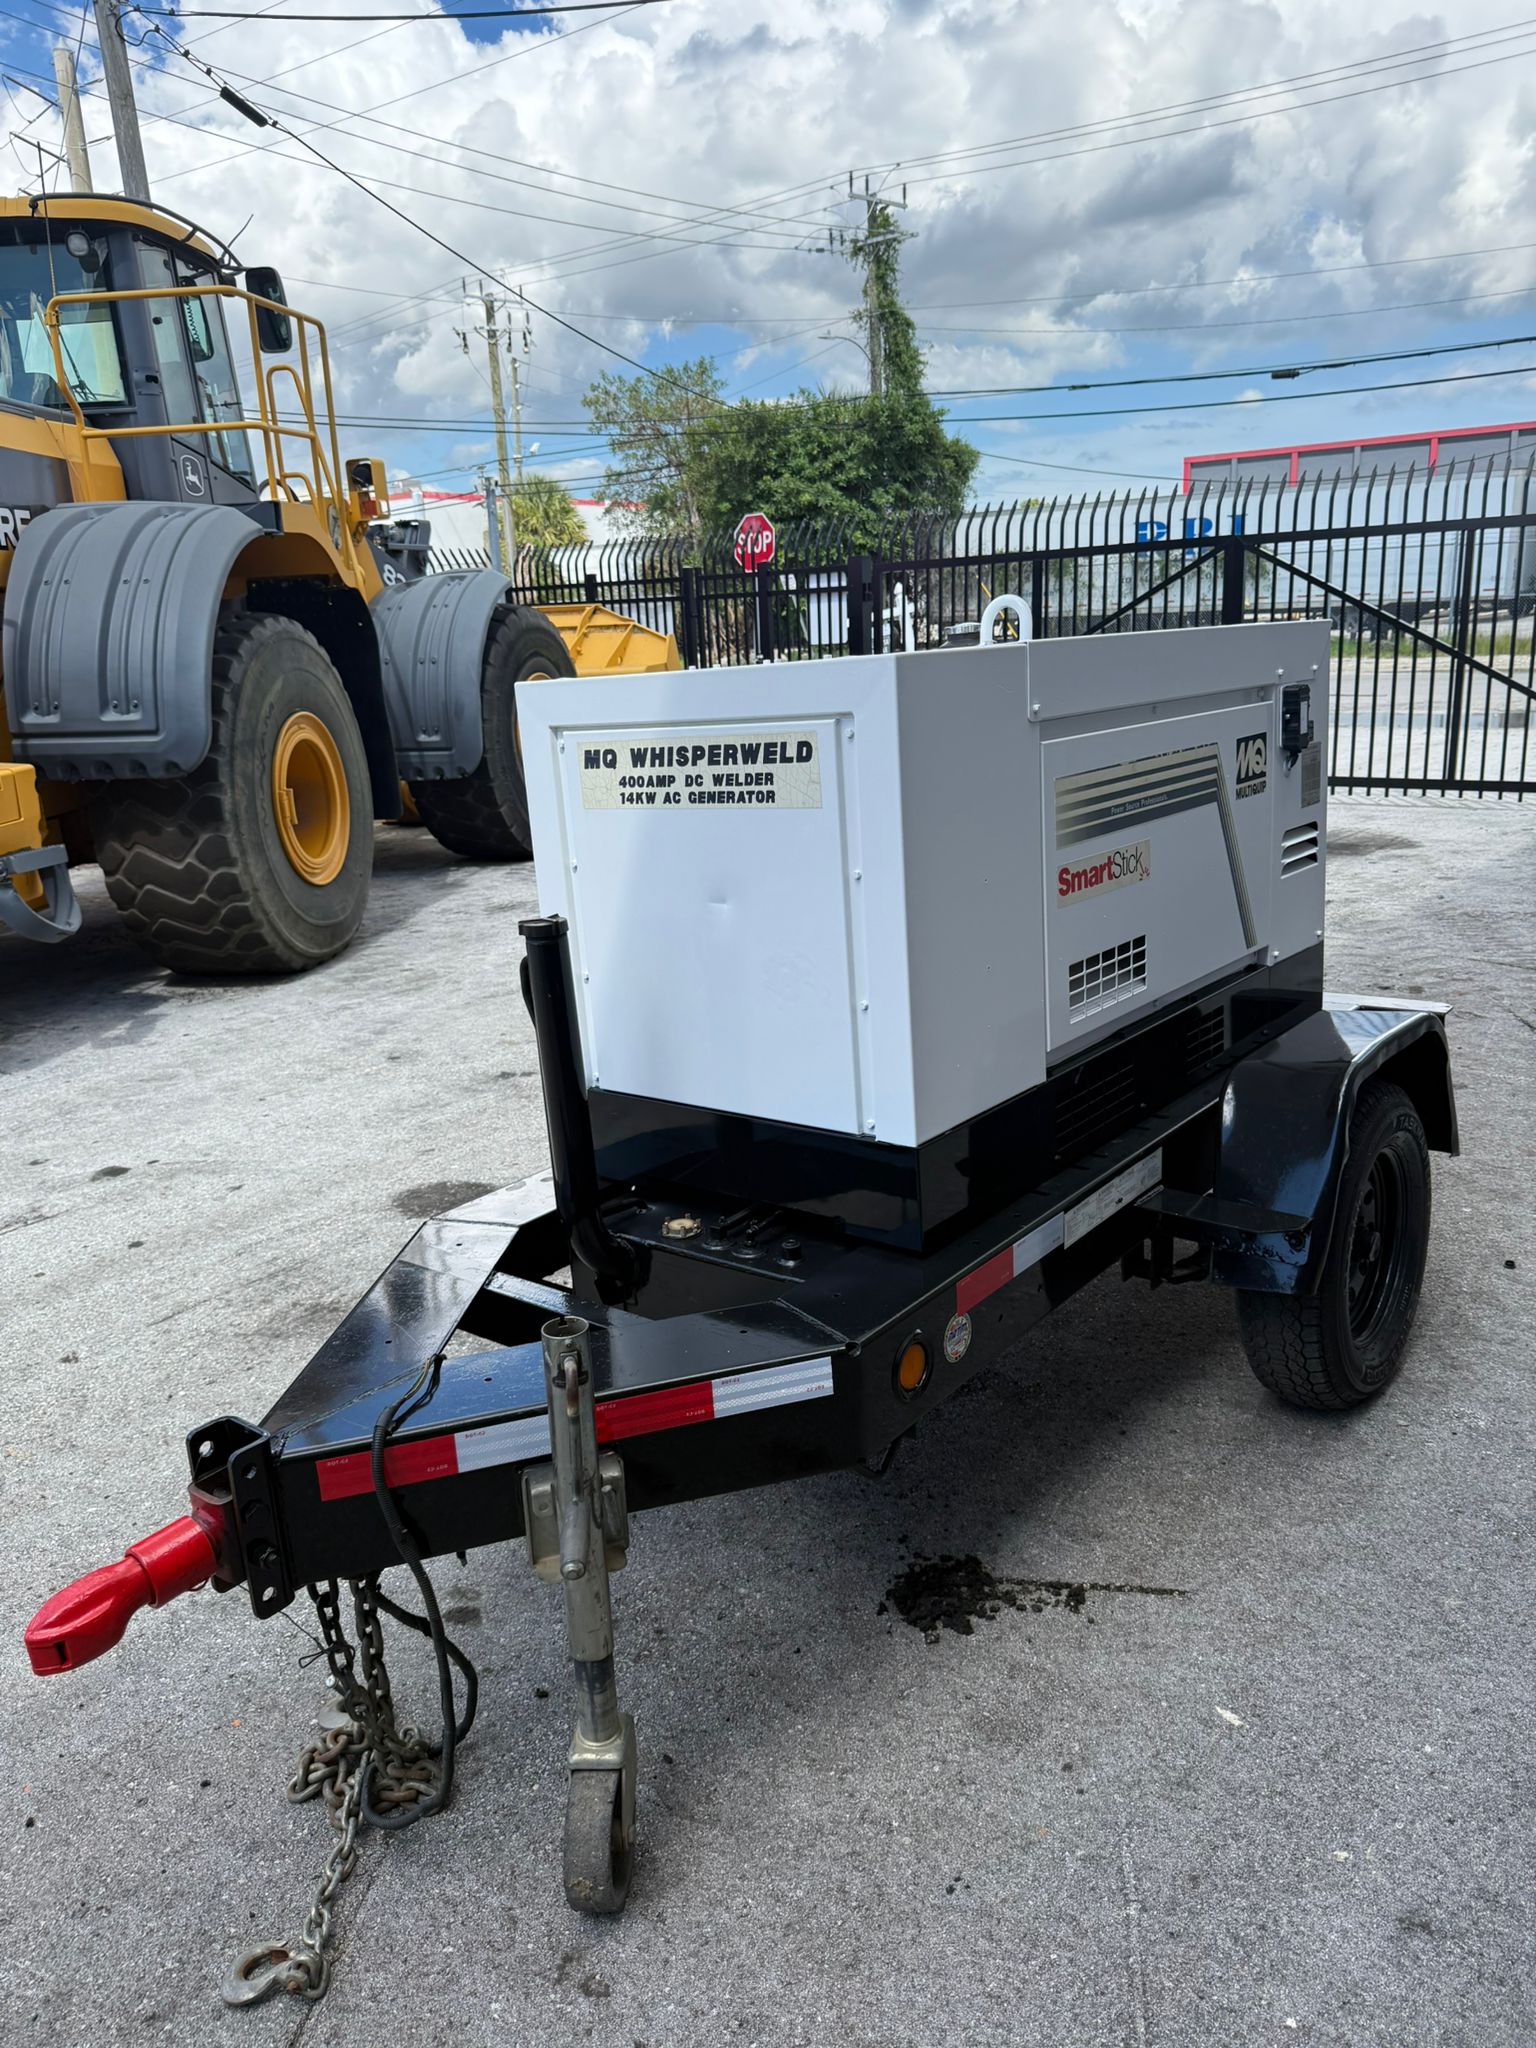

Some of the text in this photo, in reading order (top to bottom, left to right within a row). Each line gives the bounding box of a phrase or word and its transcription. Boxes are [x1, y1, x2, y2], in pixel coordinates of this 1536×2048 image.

[737, 530, 772, 555] STOP
[584, 740, 814, 770] MQ WHISPERWELD
[1236, 738, 1267, 780] MQ
[618, 772, 774, 788] 400AMP DC WELDER
[1235, 780, 1267, 800] MULTIQUIP
[619, 789, 776, 805] 14KW AC GENERATOR
[1110, 806, 1125, 816] Power
[1125, 801, 1141, 812] Source
[1058, 846, 1142, 896] SmartStick
